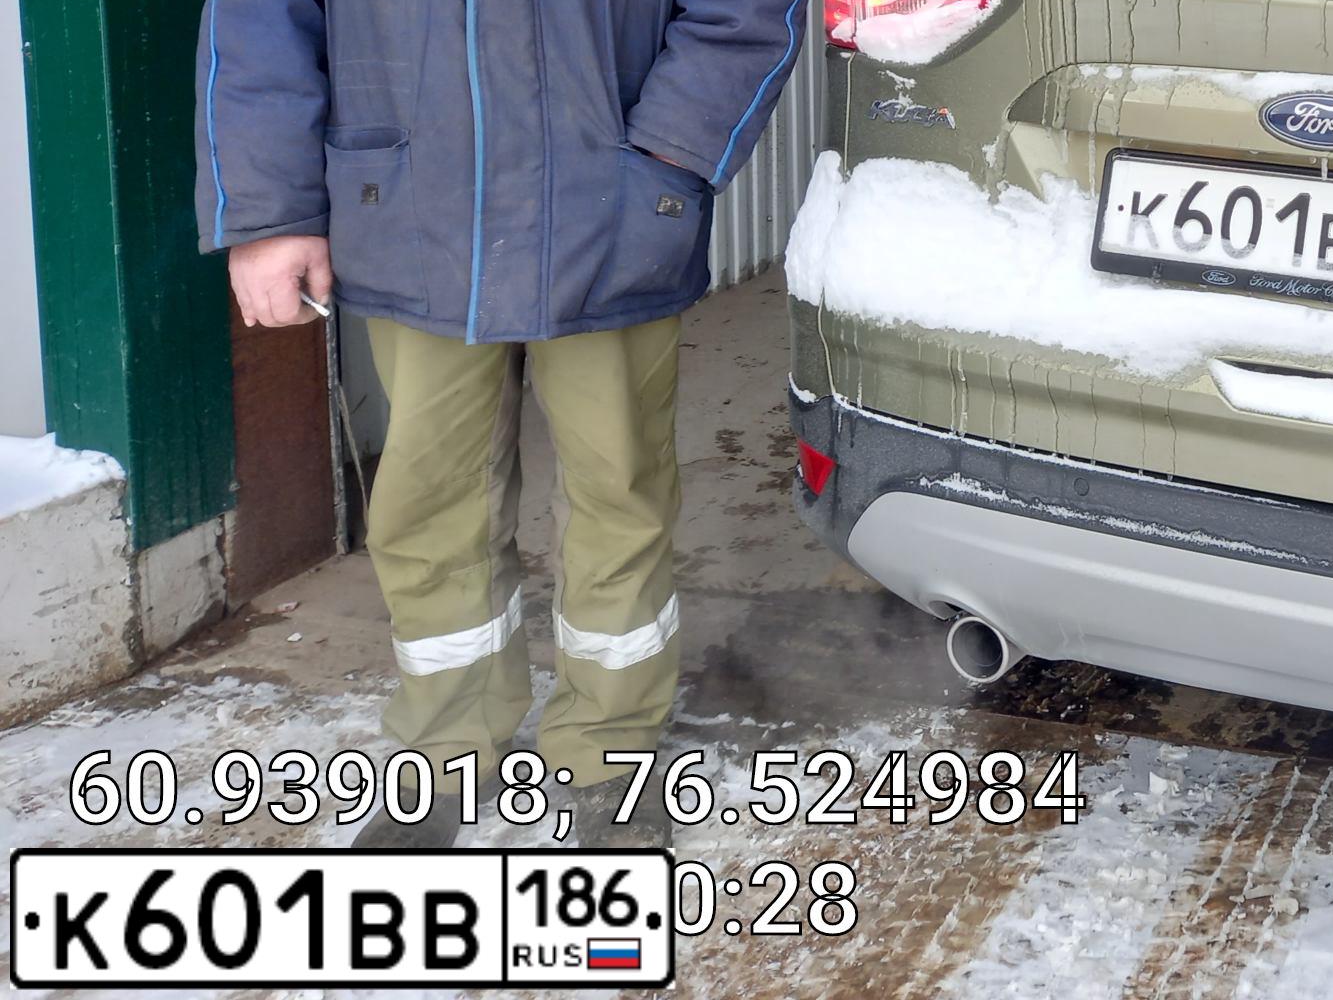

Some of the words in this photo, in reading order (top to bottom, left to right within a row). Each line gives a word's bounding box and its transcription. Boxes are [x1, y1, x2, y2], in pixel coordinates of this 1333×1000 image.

[1207, 271, 1231, 285] Ford
[1250, 273, 1284, 290] Ford
[1278, 279, 1322, 296] Motor
